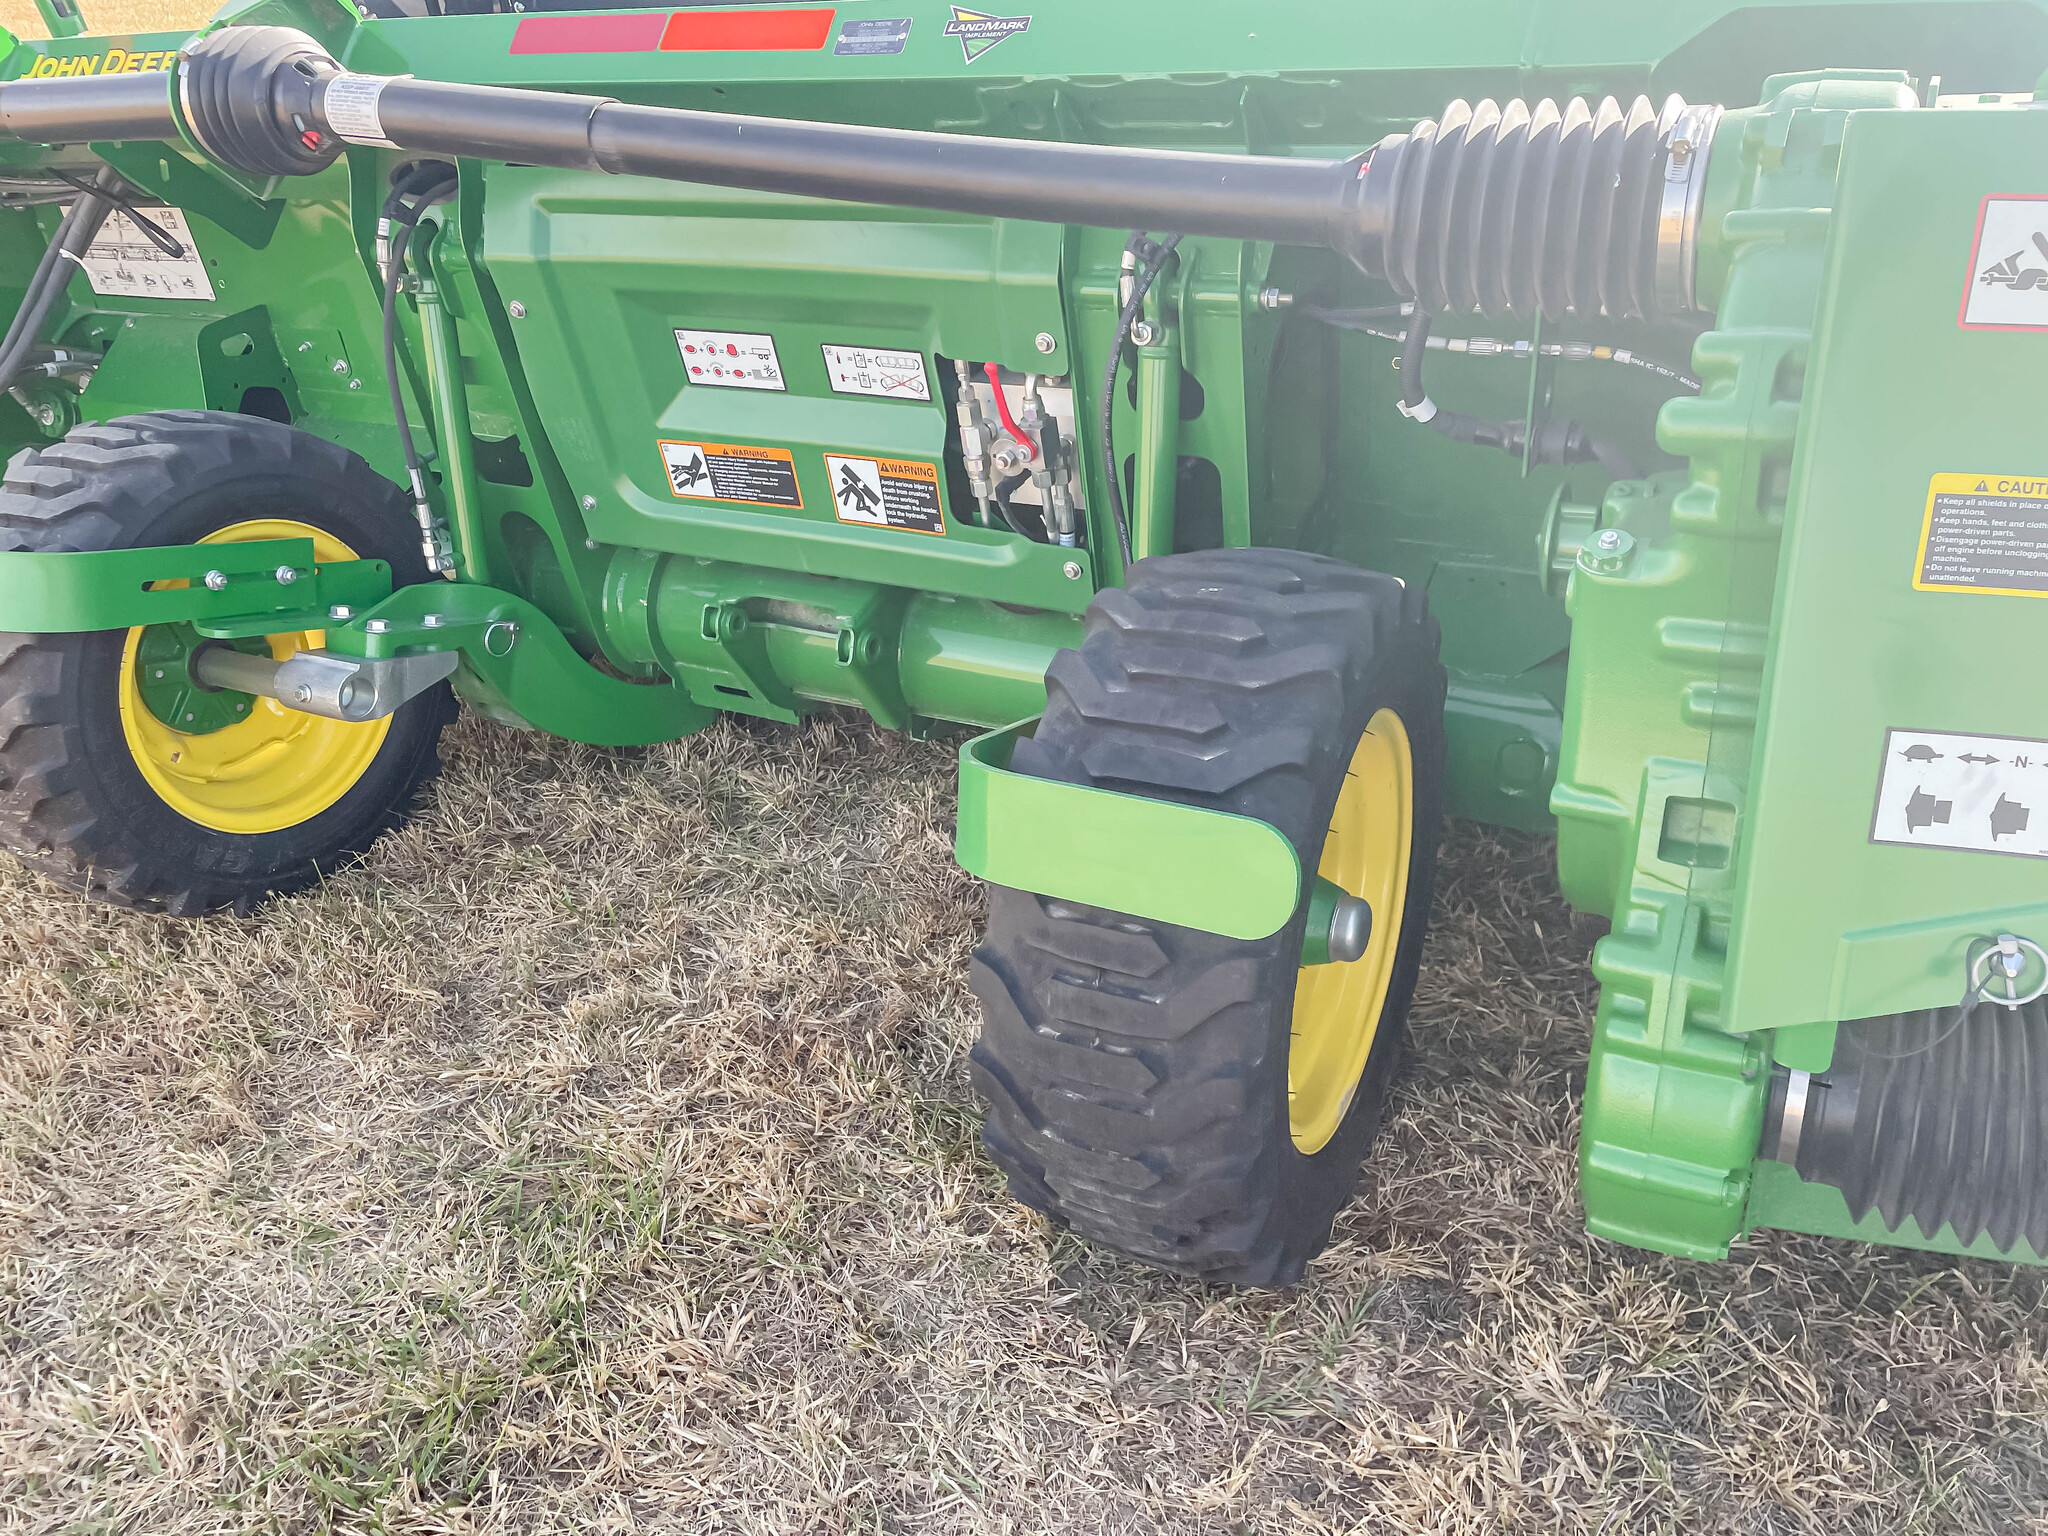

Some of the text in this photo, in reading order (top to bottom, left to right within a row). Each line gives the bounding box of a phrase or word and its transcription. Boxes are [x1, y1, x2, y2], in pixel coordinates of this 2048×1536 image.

[947, 20, 1028, 32] LANDMARK
[20, 53, 100, 79] JOHN
[731, 448, 769, 458] WARNING
[889, 464, 934, 477] WARNING
[913, 483, 928, 491] injury
[900, 497, 919, 505] working
[1943, 498, 1964, 507] Keep
[1977, 498, 2007, 507] shields
[2009, 499, 2017, 508] in
[2019, 500, 2041, 510] place
[885, 503, 912, 511] underneath
[1941, 507, 1987, 516] operations.
[1939, 516, 1960, 526] Keep
[1991, 517, 2007, 526] feet
[2008, 518, 2025, 528] and
[2026, 519, 2048, 529] cloth
[1937, 527, 2016, 538] power-driven parts.
[1936, 536, 1979, 545] Disengage
[1980, 537, 2034, 548] power-driven
[1934, 545, 1946, 553] off
[1947, 546, 1974, 555] engine
[1976, 547, 2003, 556] before
[1932, 555, 1969, 563] machine.
[1944, 564, 1957, 572] not
[1959, 565, 1981, 573] leave
[1982, 567, 2015, 576] running
[1929, 574, 1976, 583] unattended.
